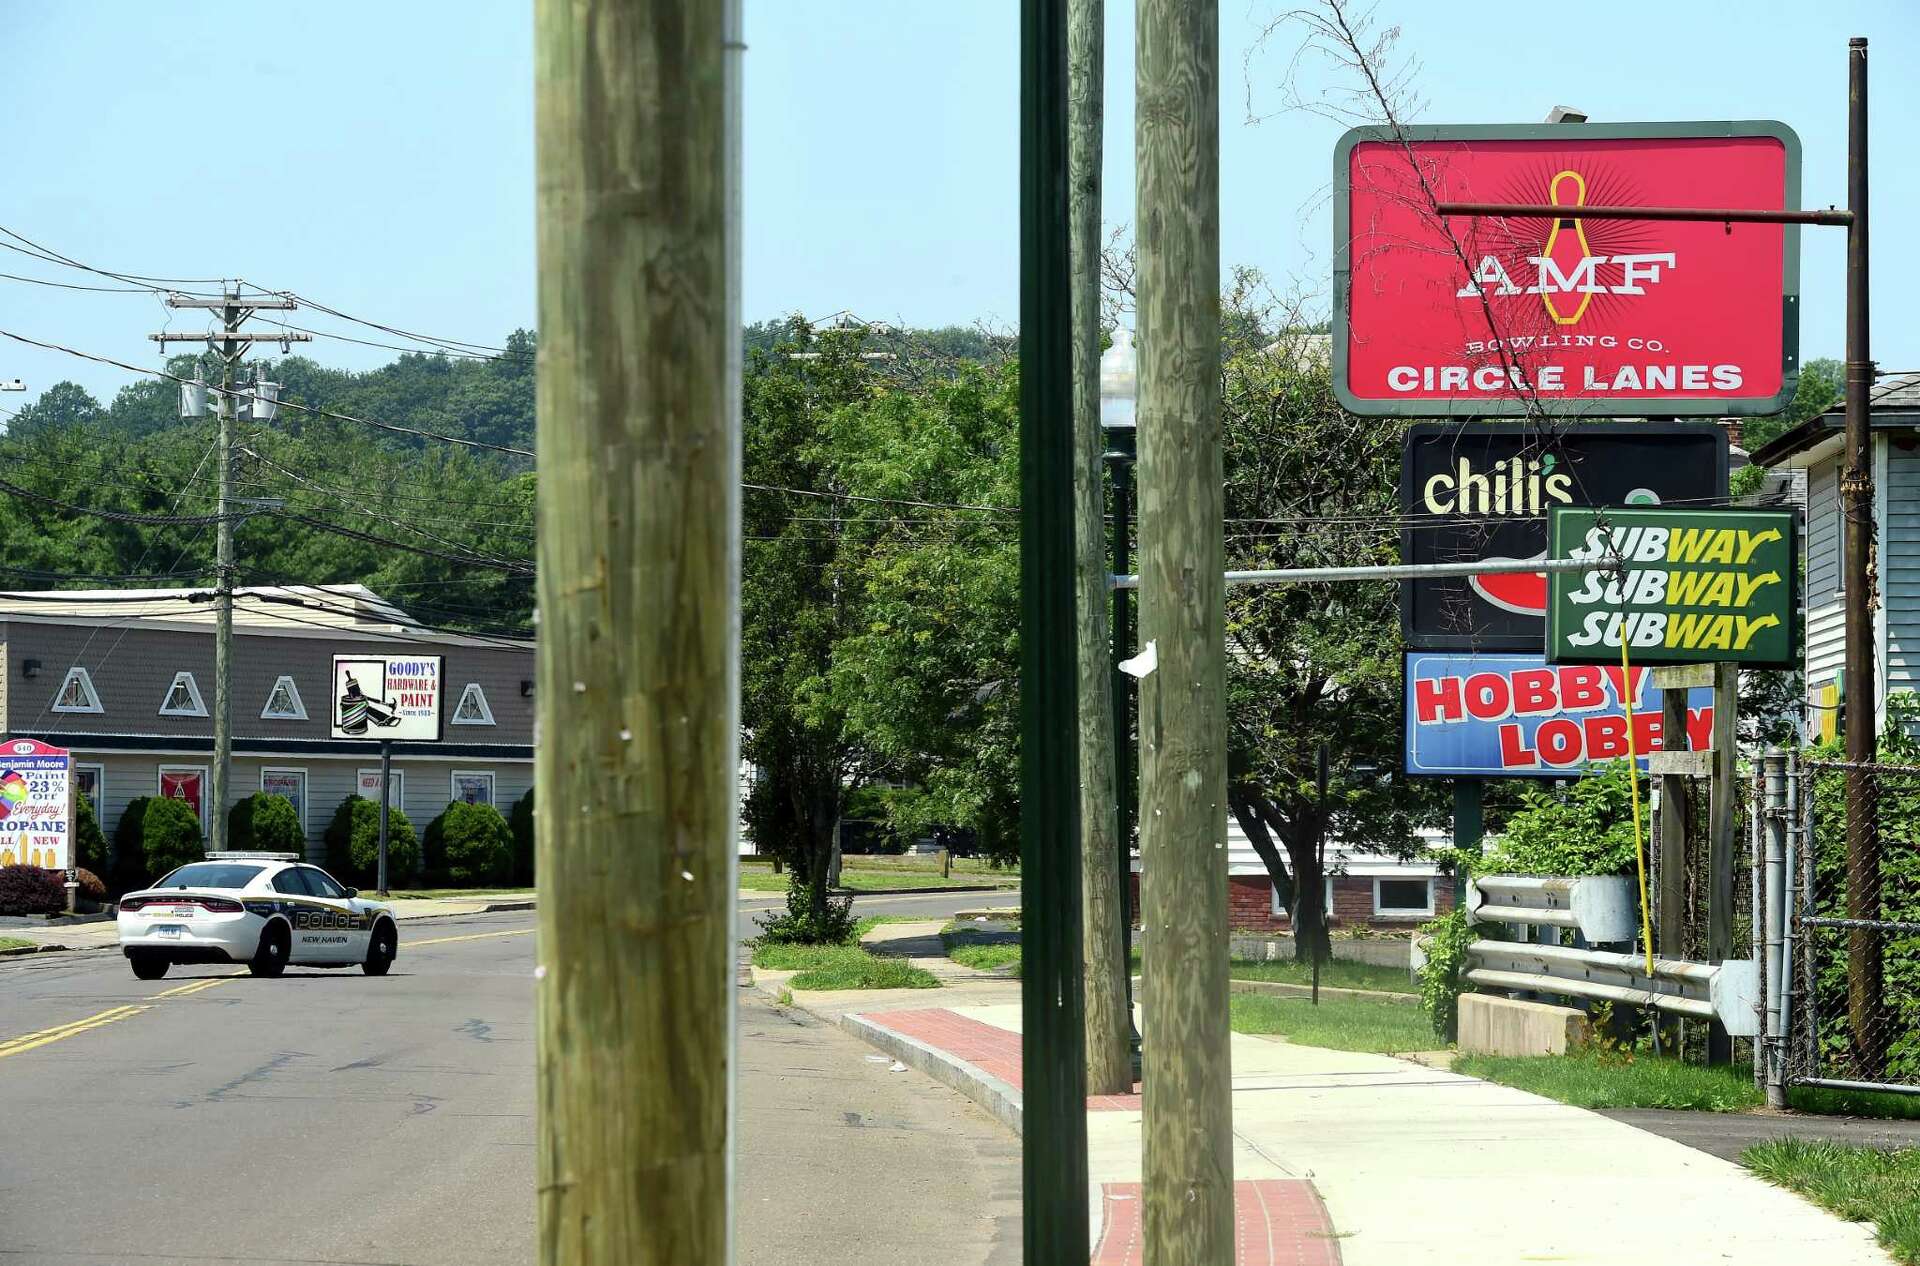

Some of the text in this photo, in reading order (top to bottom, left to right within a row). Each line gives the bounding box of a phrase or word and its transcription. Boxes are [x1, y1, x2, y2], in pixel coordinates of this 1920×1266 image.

[1456, 252, 1676, 298] AMF
[1466, 334, 1670, 355] BOWLING CO.
[1387, 364, 1743, 392] CIRCLE LANES
[1568, 527, 1783, 564] SUBWAY
[1567, 569, 1782, 607] SUBWAY
[1566, 611, 1780, 650] SUBWAY
[388, 661, 436, 676] GOODY'S
[387, 678, 436, 691] HARDWARE &
[400, 693, 434, 707] PAINT
[1414, 666, 1646, 724] HOBBY
[37, 760, 65, 769] Moore
[25, 771, 66, 780] Paint
[33, 836, 60, 845] NEW
[295, 911, 360, 930] POLICE
[301, 935, 348, 944] NEW HAVEN
